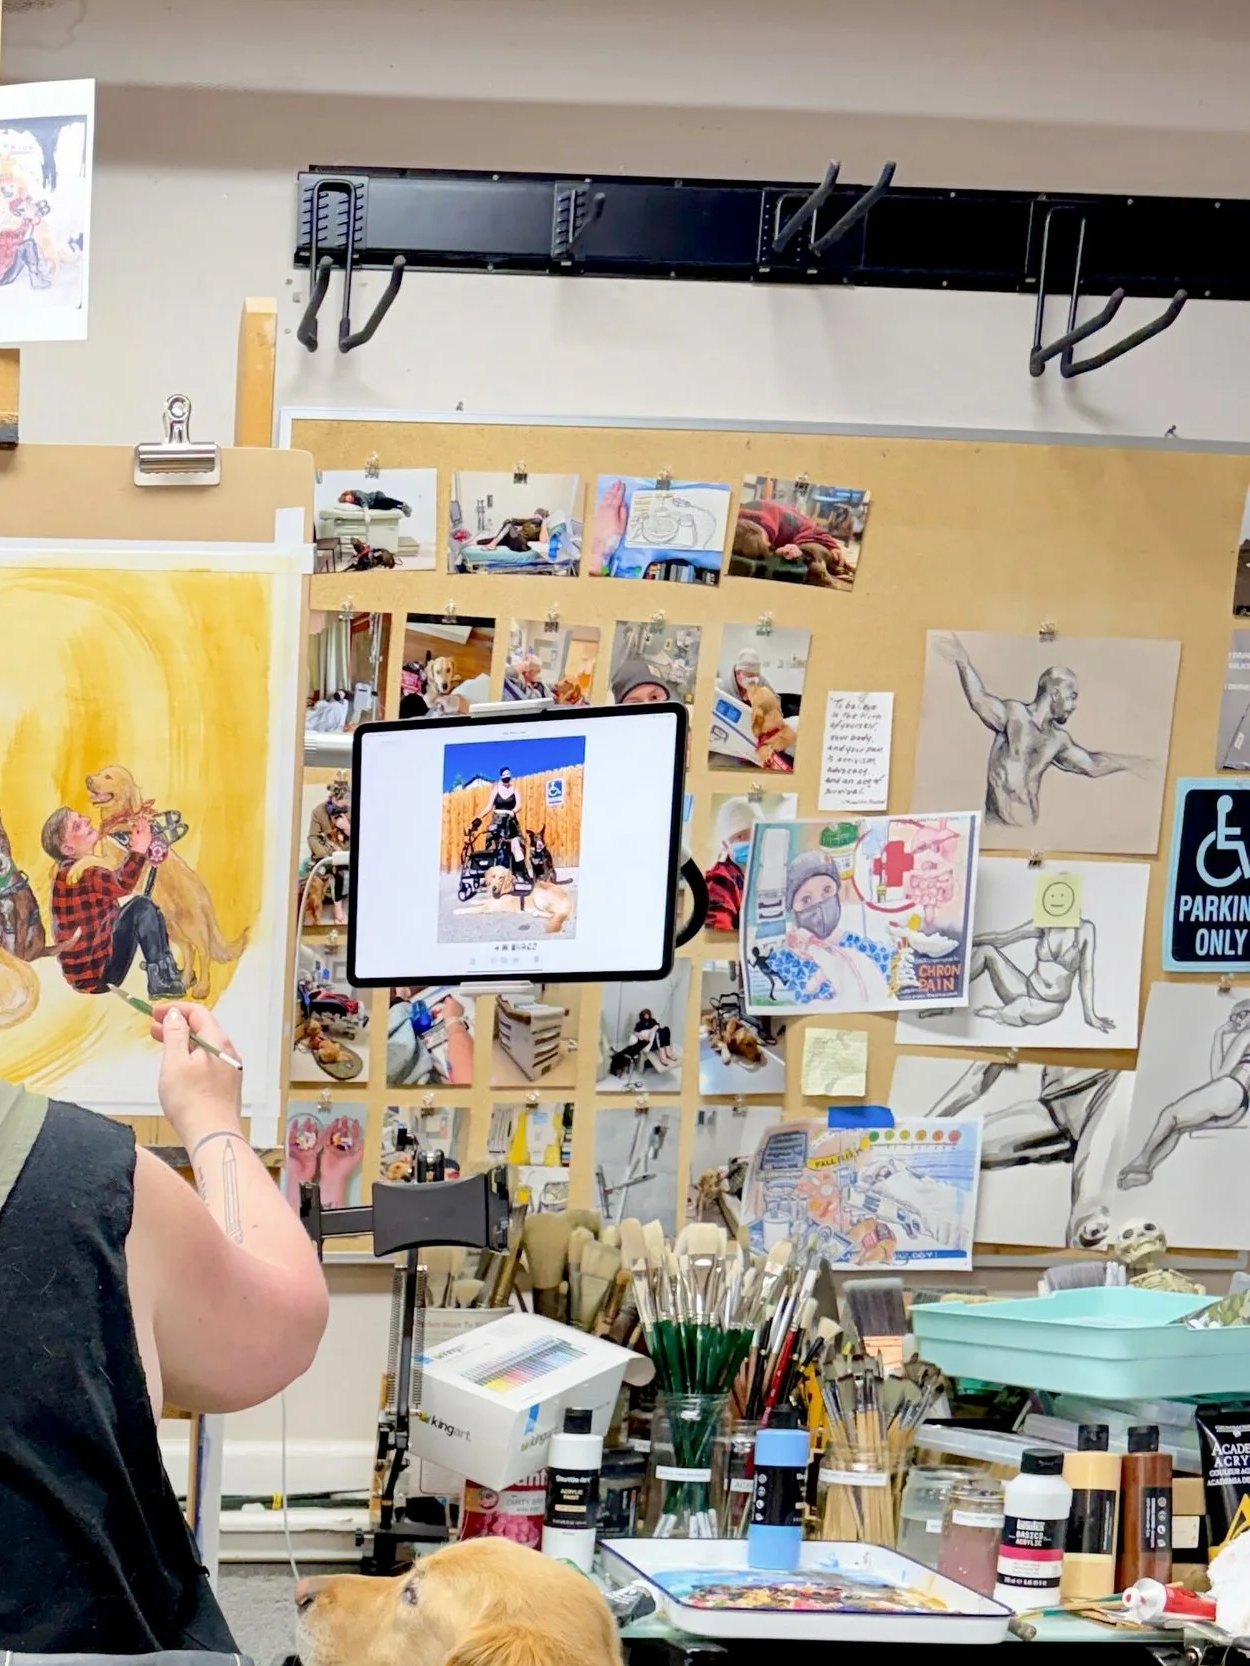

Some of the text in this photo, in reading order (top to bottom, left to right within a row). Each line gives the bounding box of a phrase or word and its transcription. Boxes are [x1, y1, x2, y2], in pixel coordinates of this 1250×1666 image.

[1195, 927, 1249, 957] ONLY
[919, 978, 955, 992] PAIN
[431, 1415, 471, 1442] kingart
[1015, 1530, 1044, 1541] BASICS
